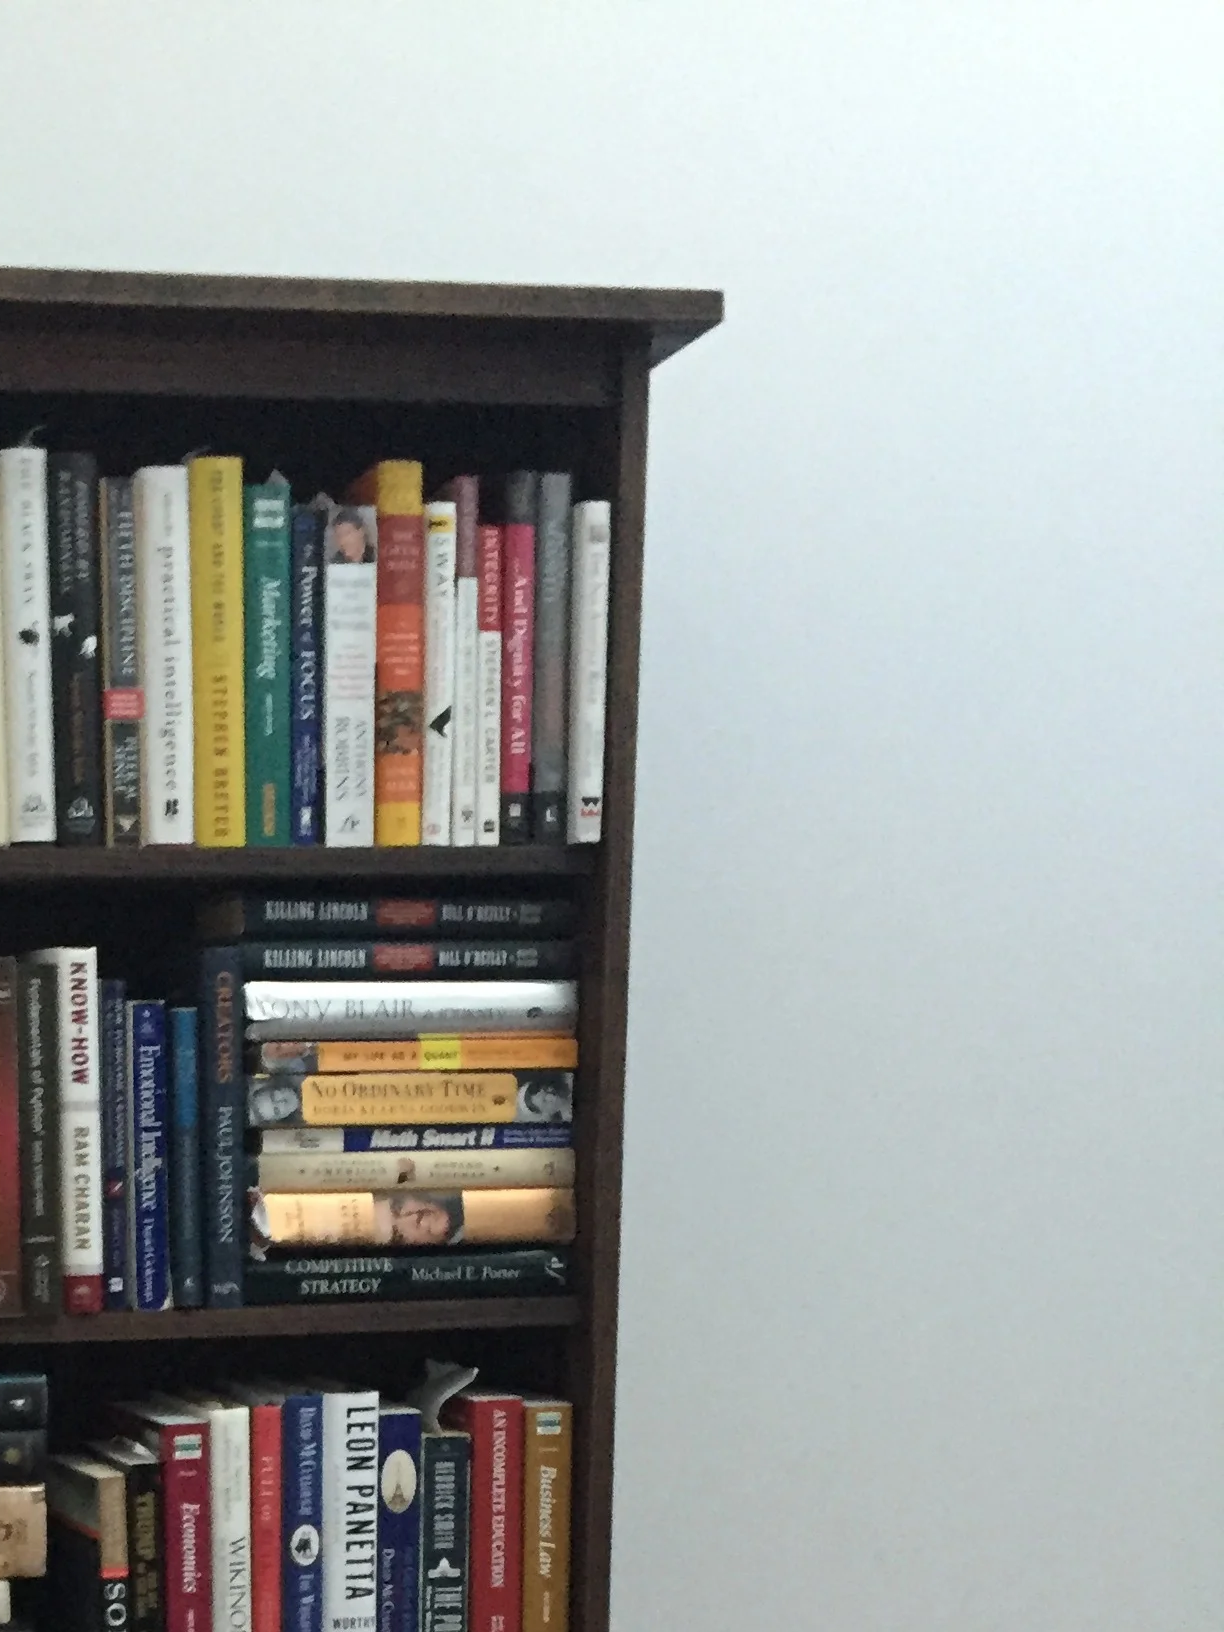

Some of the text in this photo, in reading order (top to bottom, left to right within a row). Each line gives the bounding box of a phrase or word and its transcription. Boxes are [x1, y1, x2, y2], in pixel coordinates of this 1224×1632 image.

[433, 535, 450, 598] SWAY
[485, 528, 498, 625] INTEGRITY
[157, 546, 183, 791] practical intelligence
[256, 577, 281, 680] Marketing
[298, 565, 316, 720] Power FOCUS
[508, 617, 528, 755] Dignity for All
[334, 715, 349, 801] ROBBINS
[28, 978, 45, 1083] Fundamentals of
[71, 962, 89, 1085] KNOW-HOW
[217, 971, 232, 1084] CREATORS
[345, 999, 415, 1020] BLAIR
[135, 1045, 163, 1210] Emotional Intelligence
[217, 1106, 234, 1243] PAUL JOHNSON
[73, 1126, 92, 1249] RAM CHARAN
[285, 1259, 394, 1275] COMPETITIVE
[300, 1278, 381, 1294] STRATEGY
[411, 1267, 520, 1281] Michael Porter
[181, 1502, 201, 1594] Economics
[344, 1406, 376, 1601] LEON PANETTA
[491, 1409, 506, 1588] AN INCOMPLETE EDUCATION
[538, 1465, 556, 1579] Business Law
[434, 1586, 461, 1609] THE
